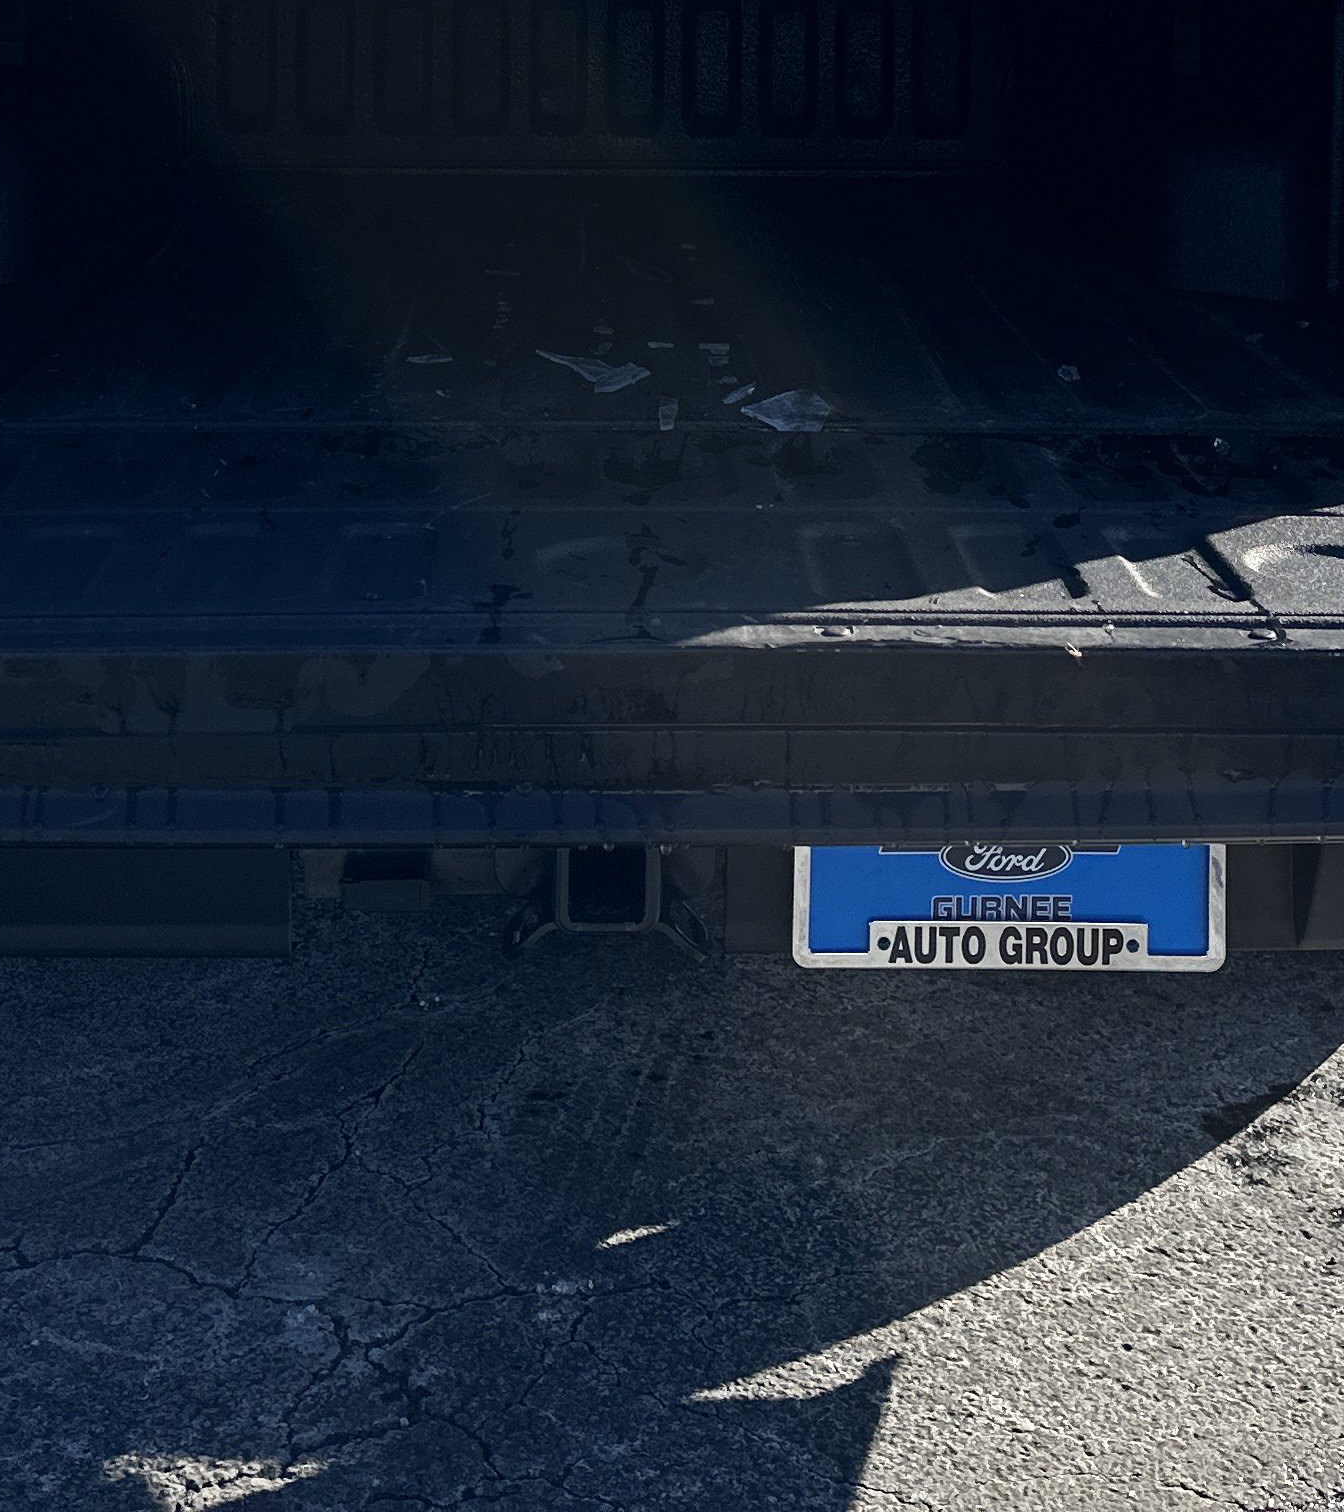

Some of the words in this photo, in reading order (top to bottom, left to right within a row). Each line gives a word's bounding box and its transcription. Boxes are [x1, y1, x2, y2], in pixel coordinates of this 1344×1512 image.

[965, 844, 1044, 873] Ford
[930, 894, 1073, 922] GURNEE
[889, 927, 987, 966] AUTO
[998, 927, 1125, 967] GROUP
